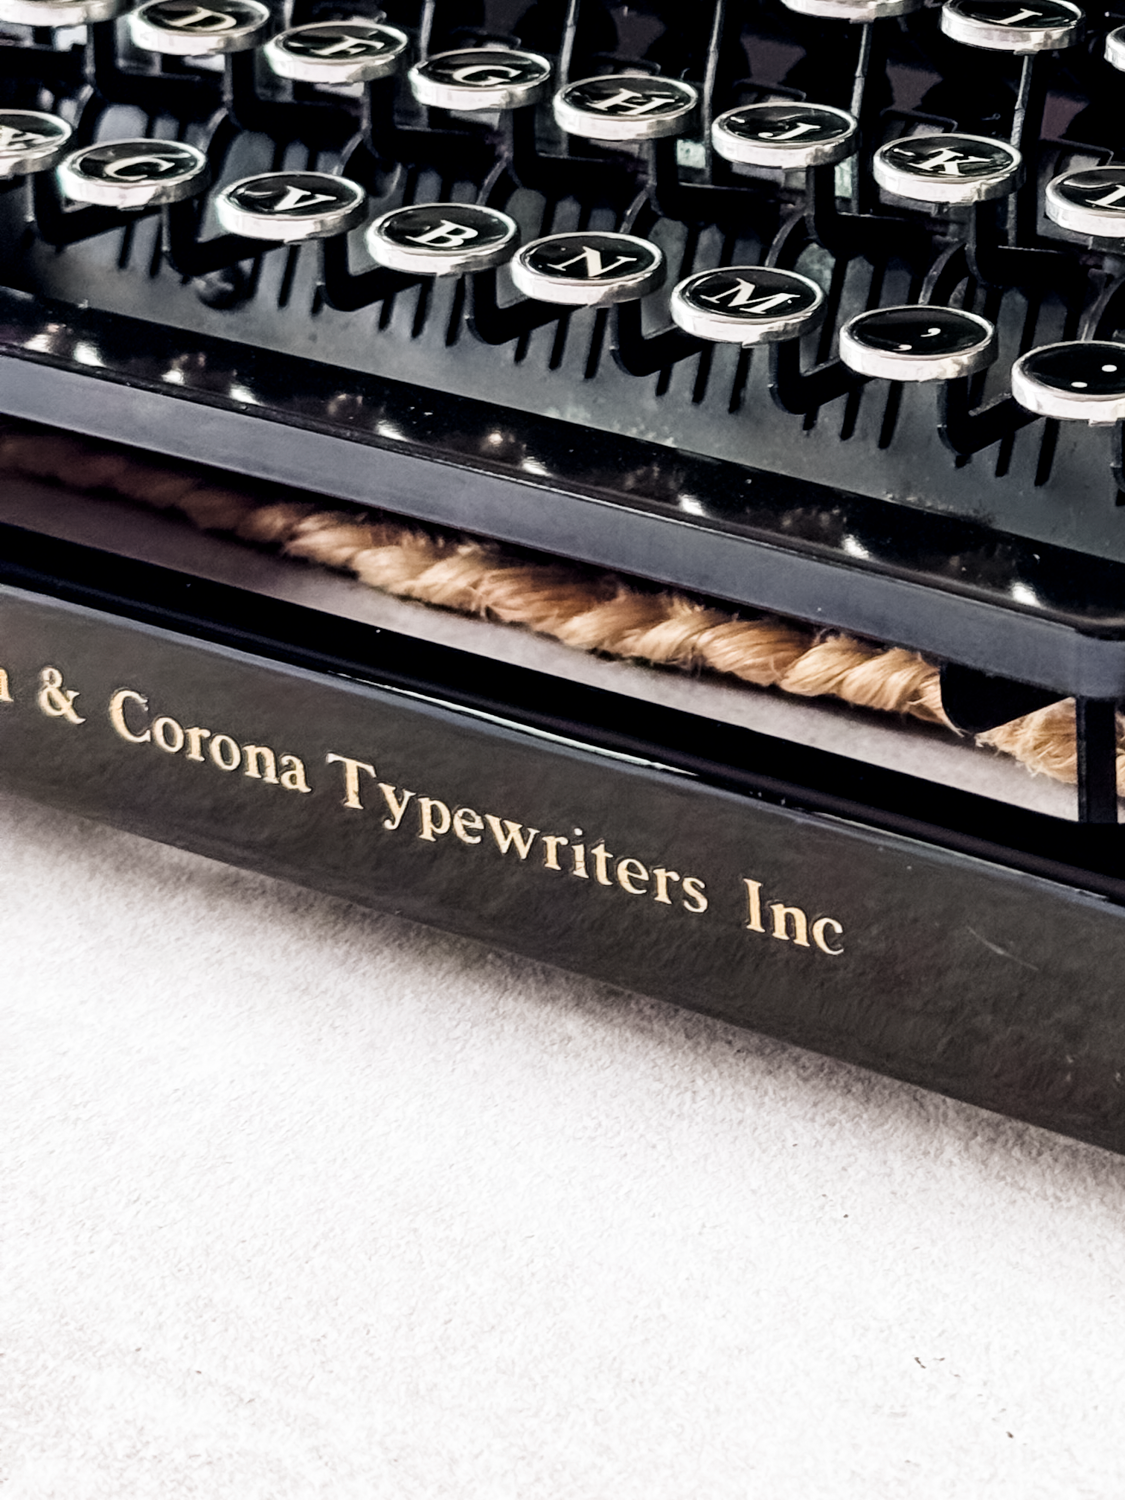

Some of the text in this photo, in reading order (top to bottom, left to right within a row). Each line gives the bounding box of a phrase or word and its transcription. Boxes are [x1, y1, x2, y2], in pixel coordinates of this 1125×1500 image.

[170, 5, 238, 33] D
[309, 34, 386, 57] F
[452, 64, 524, 86] G
[590, 88, 675, 116] H
[757, 121, 822, 142] J
[104, 156, 176, 181] C
[913, 147, 994, 176] K
[273, 185, 338, 211] V
[405, 219, 479, 249] B
[547, 246, 638, 278] N
[699, 278, 801, 315] M
[38, 666, 86, 724] &
[109, 688, 312, 793] Corona
[326, 753, 708, 913] Typewriters
[743, 877, 845, 955] Inc
